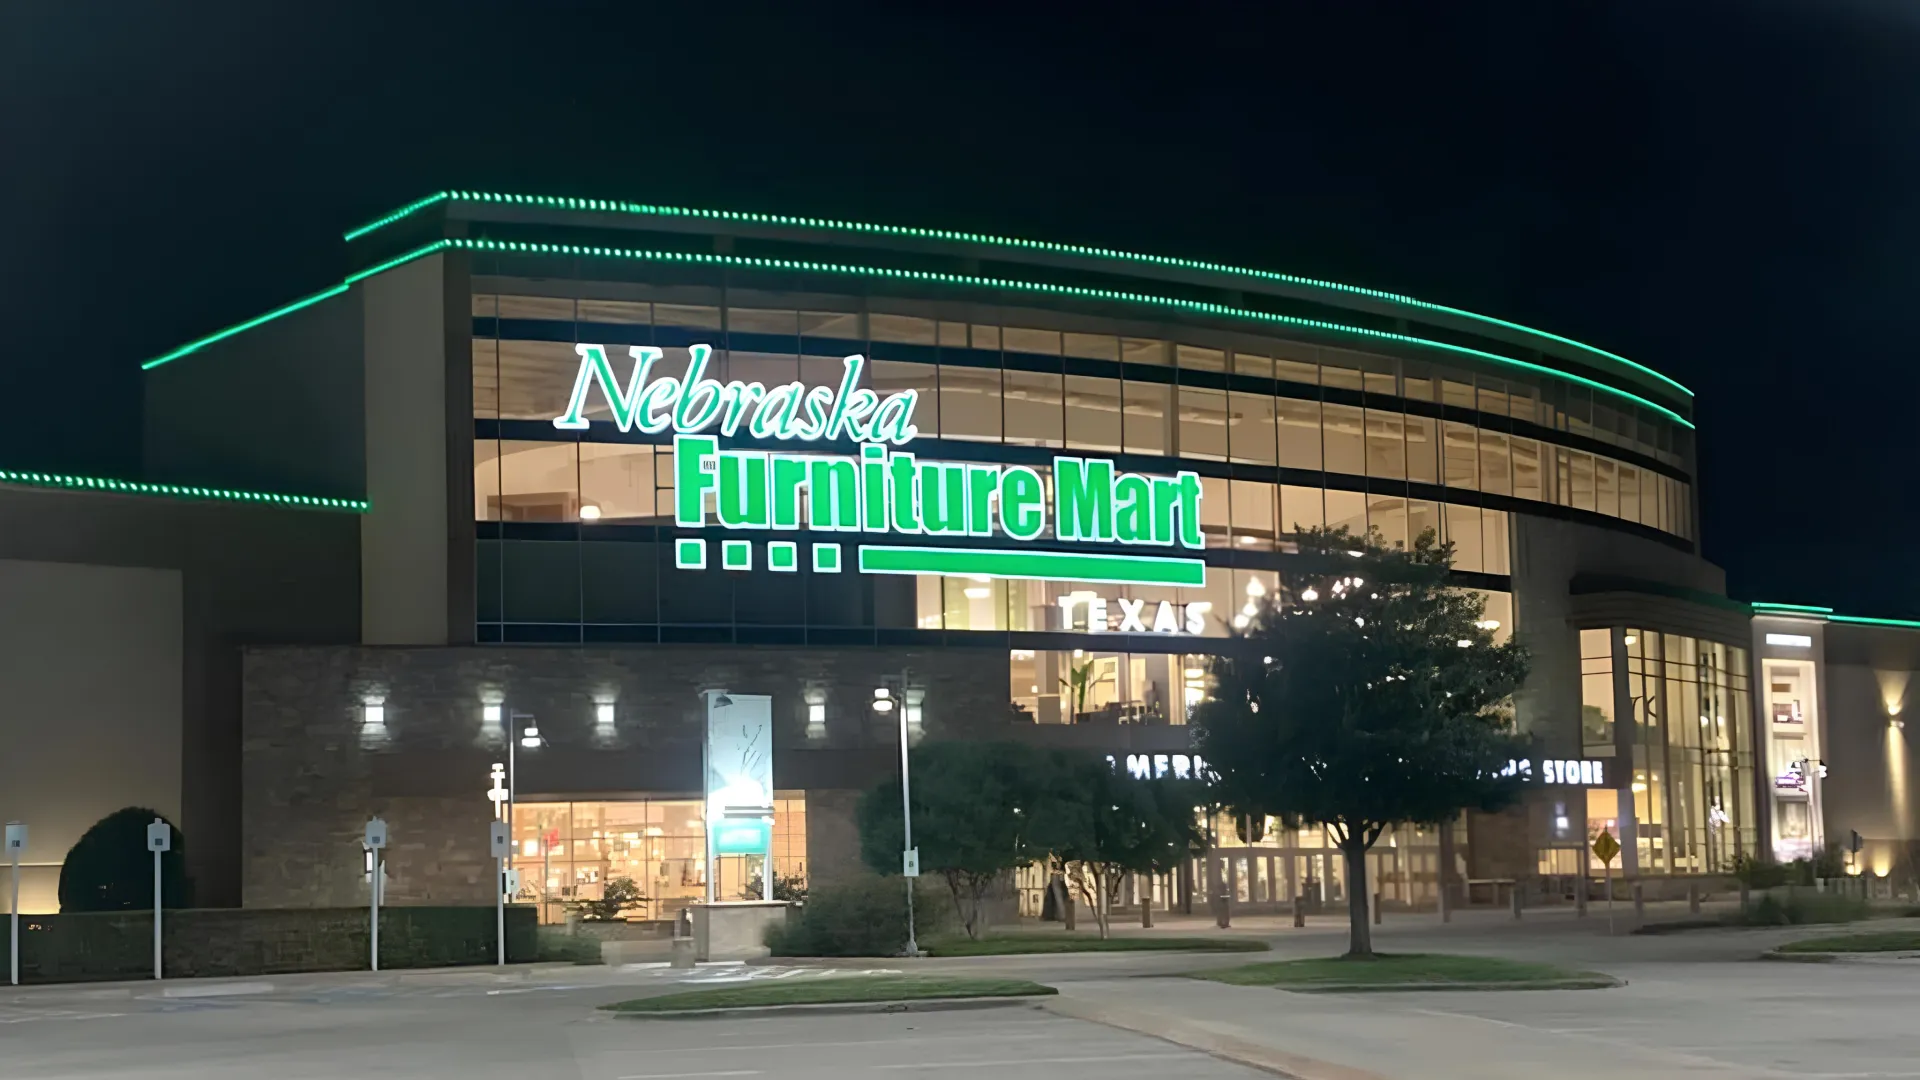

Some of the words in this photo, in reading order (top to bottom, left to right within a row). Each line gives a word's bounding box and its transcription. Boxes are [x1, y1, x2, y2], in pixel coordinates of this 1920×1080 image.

[553, 343, 918, 445] Nebraska
[673, 434, 1045, 541] Furniture
[1054, 456, 1205, 550] Mart
[1058, 591, 1212, 635] TEXAS
[1543, 760, 1603, 784] STORE
